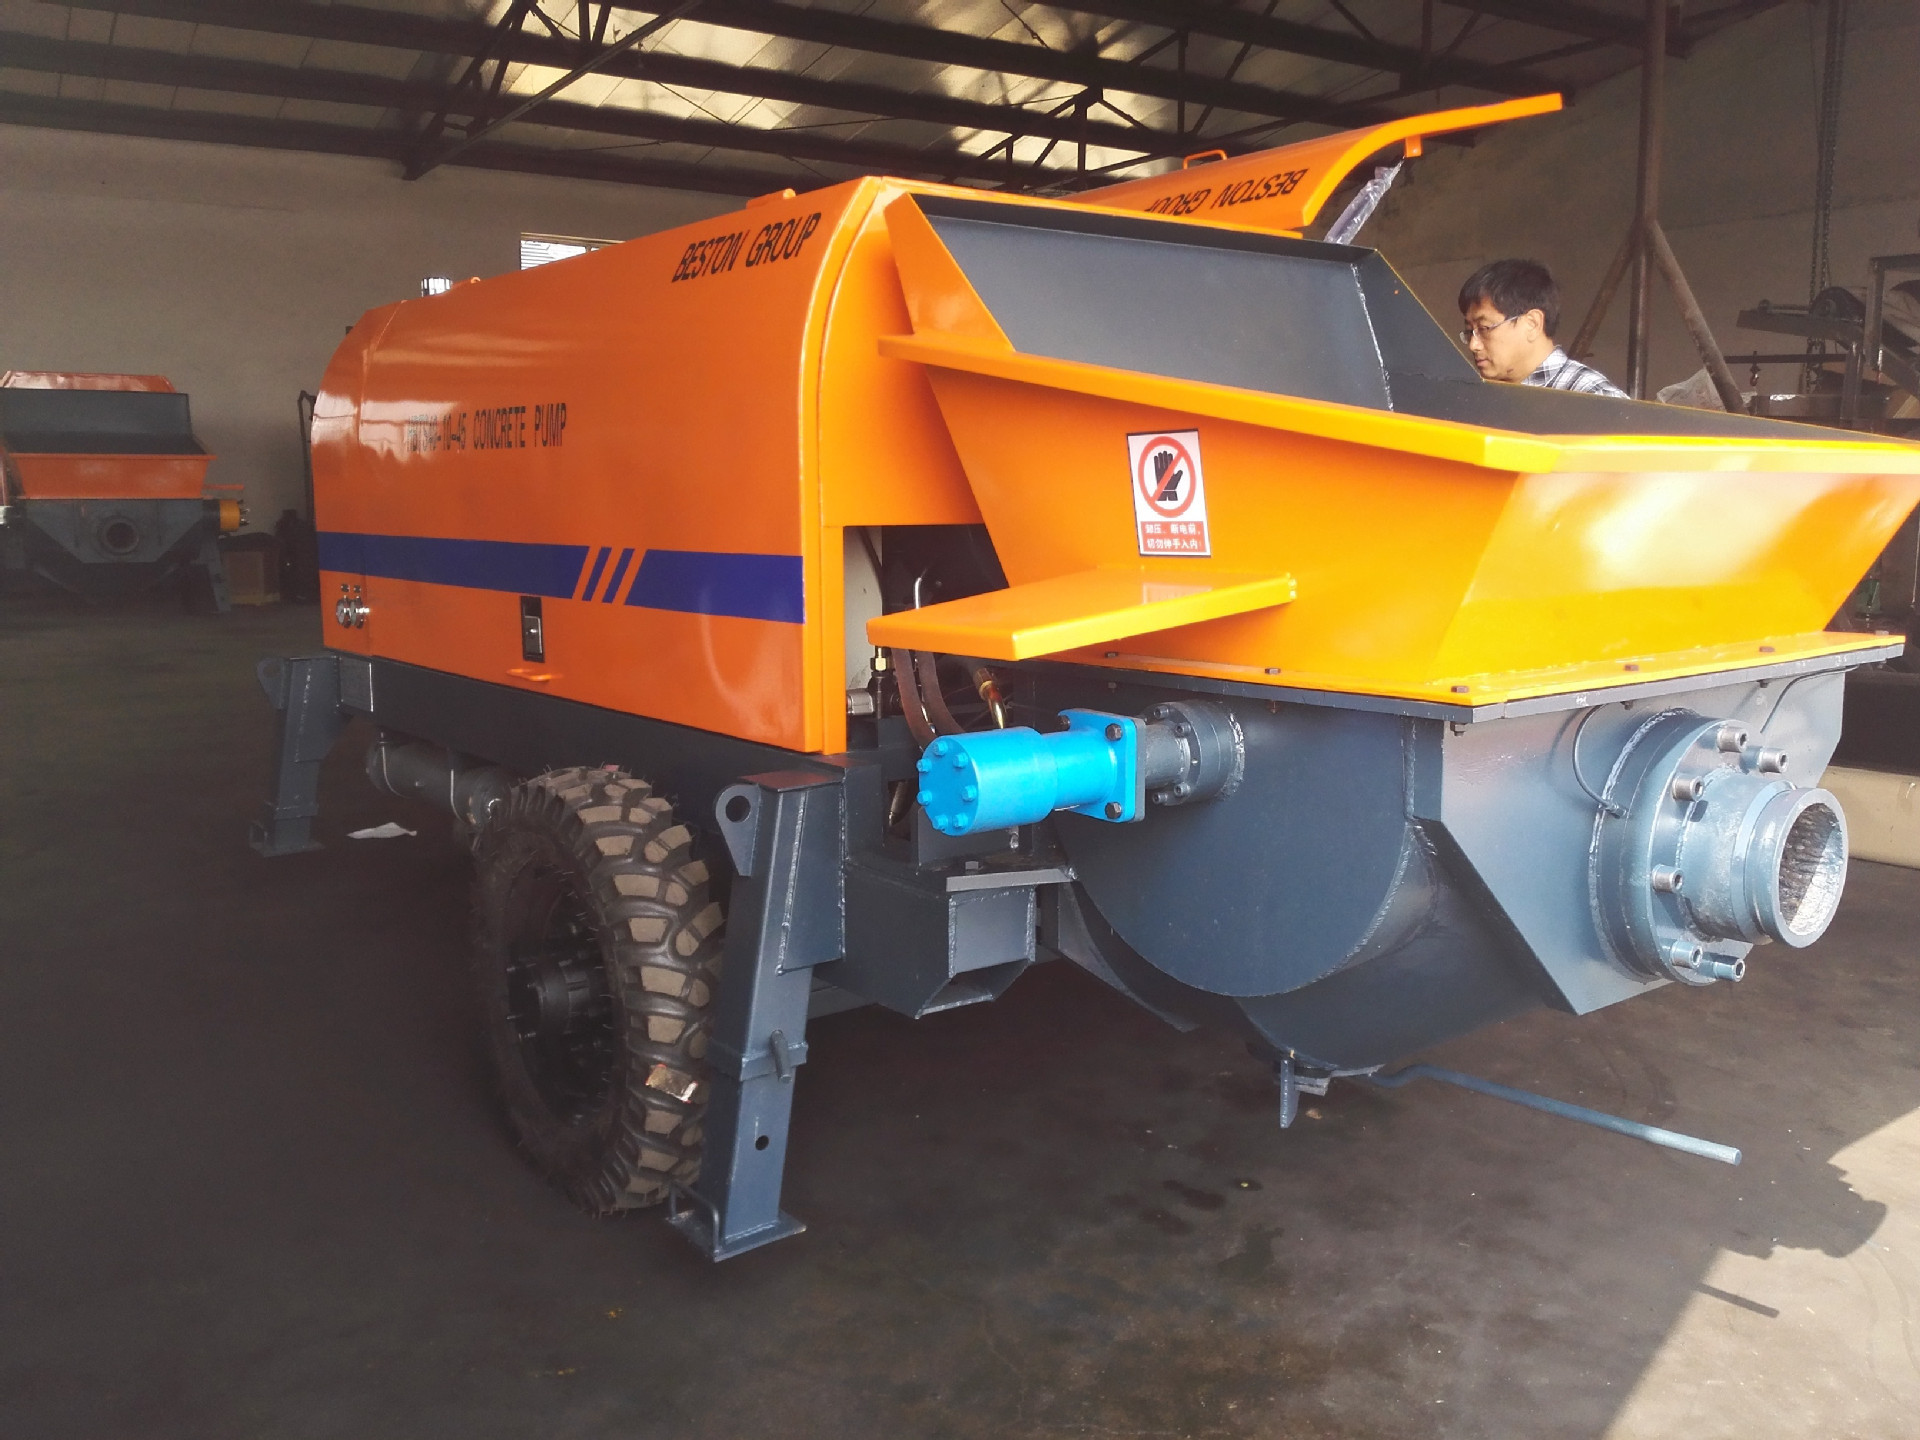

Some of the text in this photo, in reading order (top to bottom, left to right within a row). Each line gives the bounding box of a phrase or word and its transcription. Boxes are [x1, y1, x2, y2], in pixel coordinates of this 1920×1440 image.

[1210, 168, 1310, 209] BESTON
[671, 212, 822, 283] BESTON GROUP
[473, 405, 527, 450] CONCRETE
[534, 402, 567, 448] PUMP
